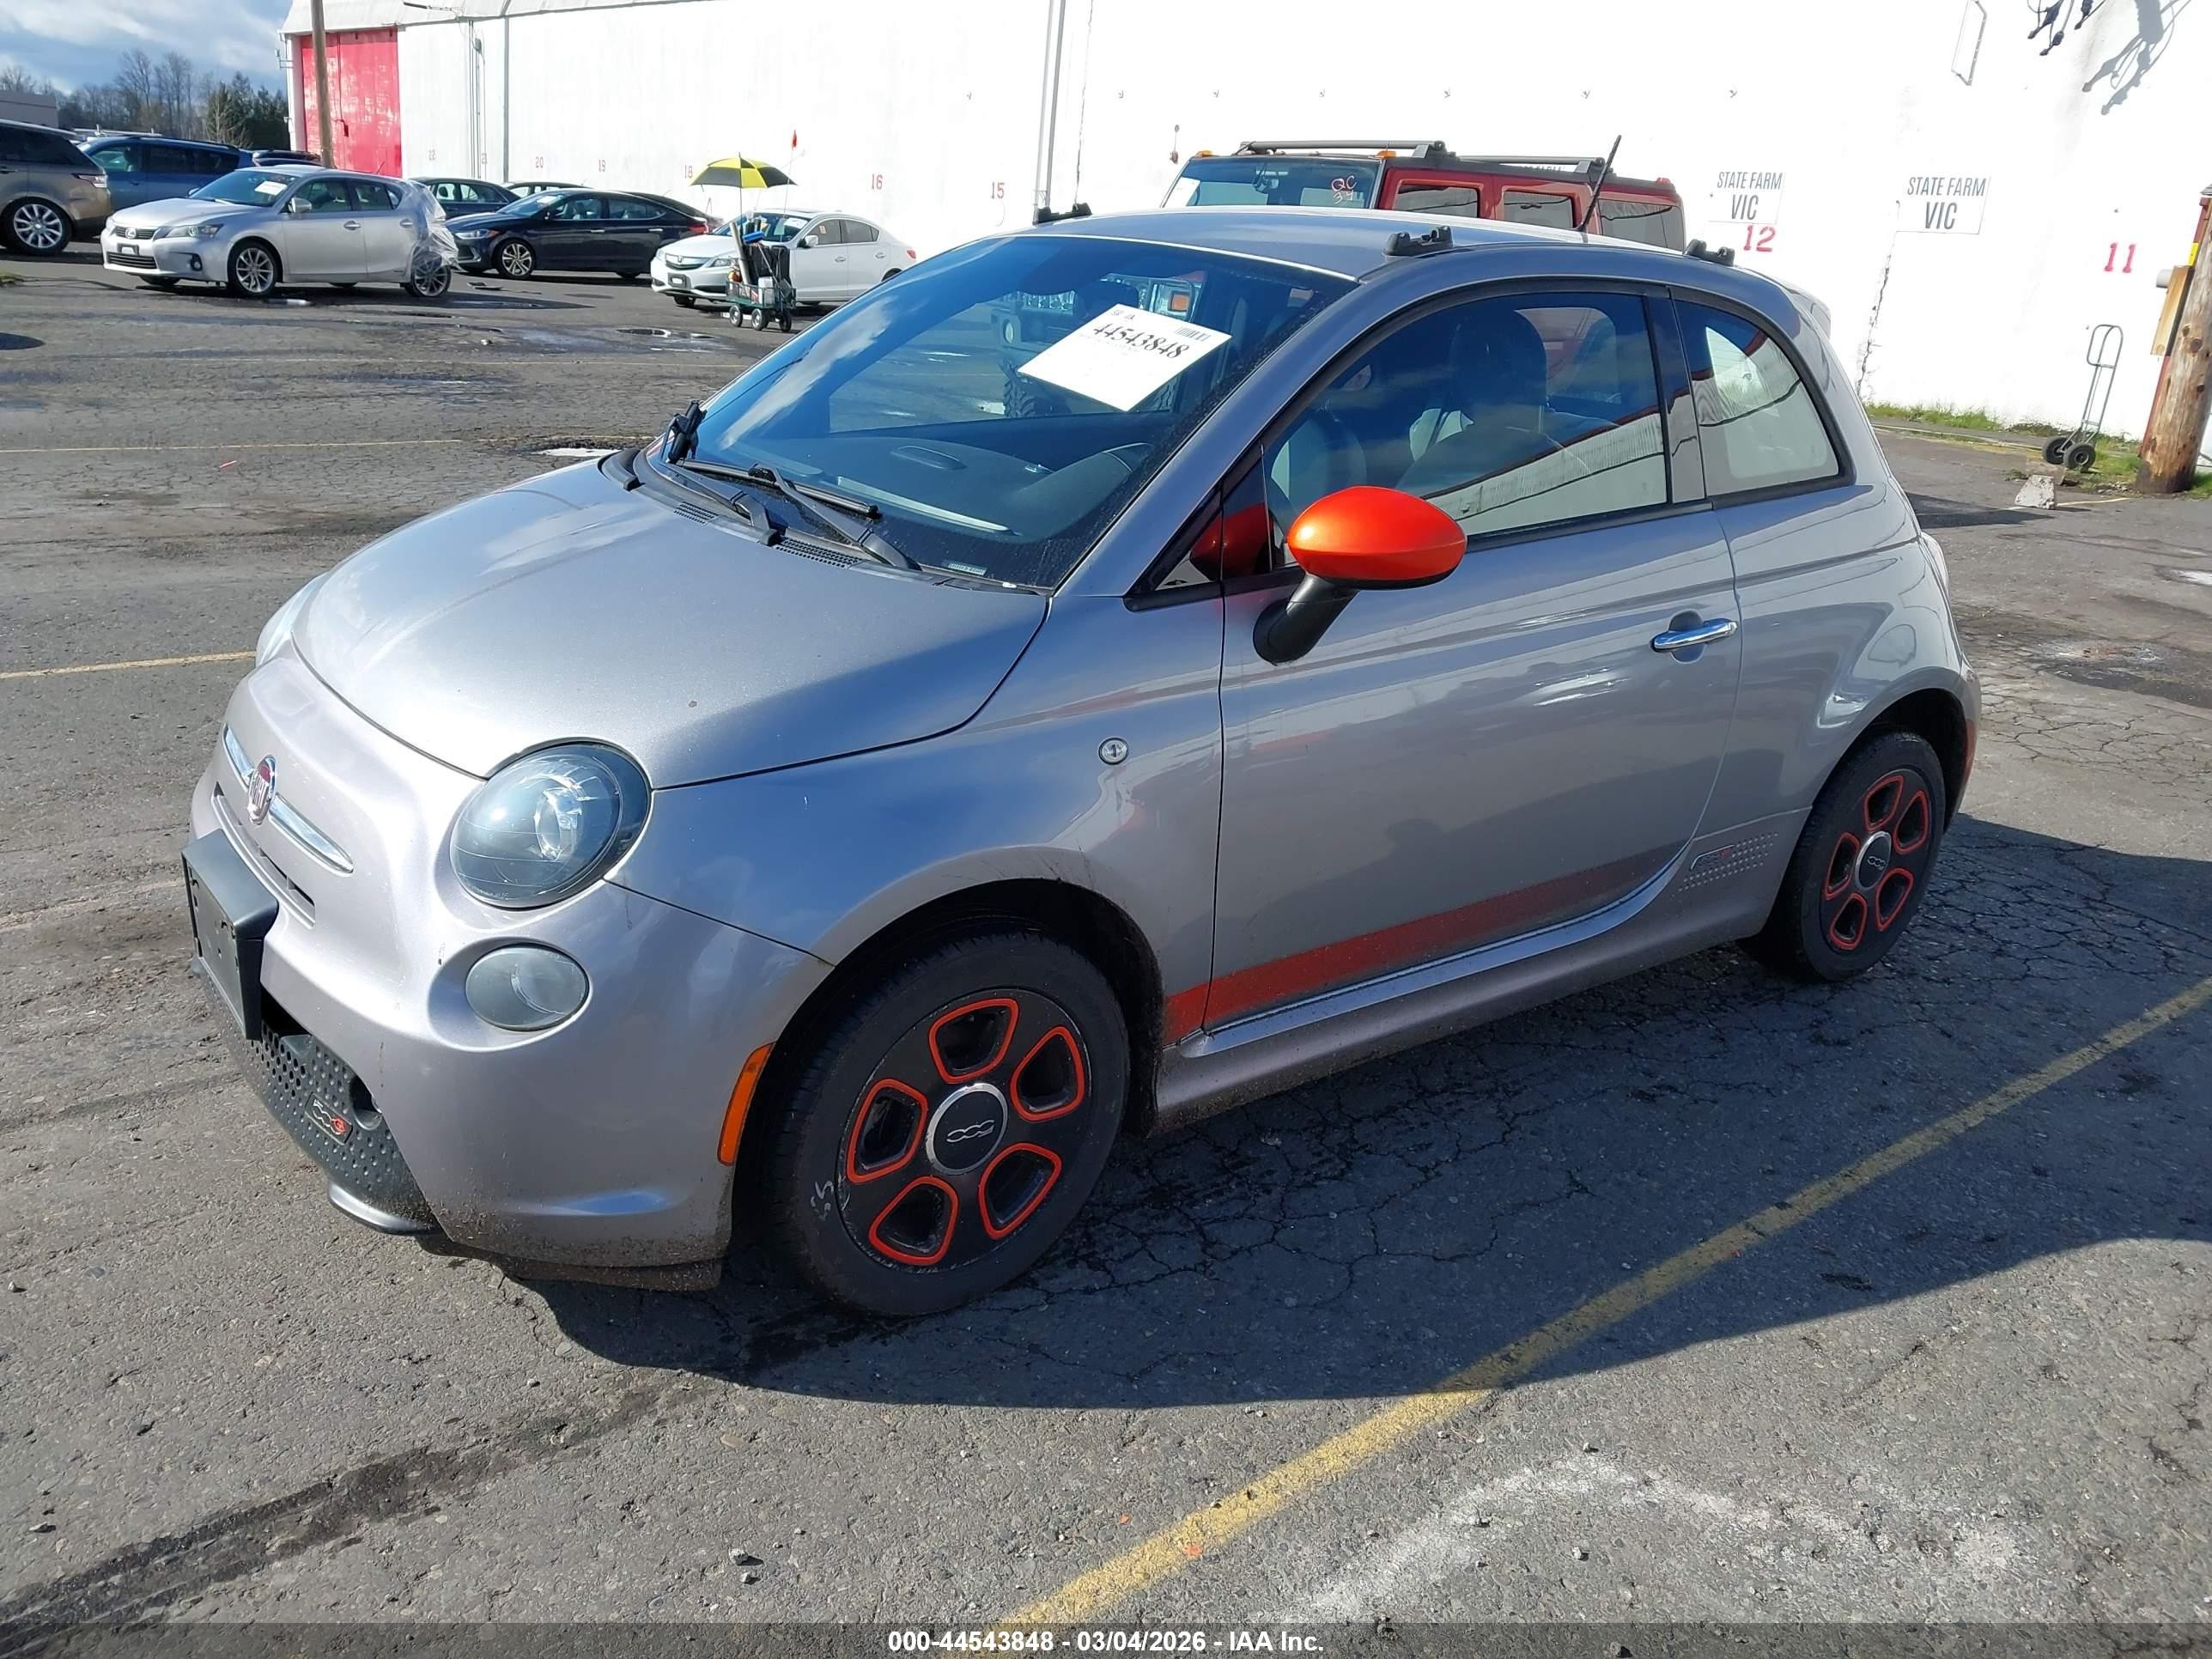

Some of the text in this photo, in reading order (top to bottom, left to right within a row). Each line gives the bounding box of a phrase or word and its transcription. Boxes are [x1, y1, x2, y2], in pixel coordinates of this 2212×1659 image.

[535, 156, 544, 168] 20
[599, 160, 606, 173] 19
[684, 165, 693, 179] 18
[1717, 171, 1784, 190] STATE FARM
[872, 173, 884, 191] 16
[991, 181, 1006, 199] 15
[1907, 177, 1987, 197] STATE FARM
[1731, 194, 1759, 221] VIC
[1925, 201, 1958, 230] VIC
[1743, 225, 1776, 252] 12
[2104, 242, 2136, 274] 11
[1093, 323, 1190, 359] 44543848
